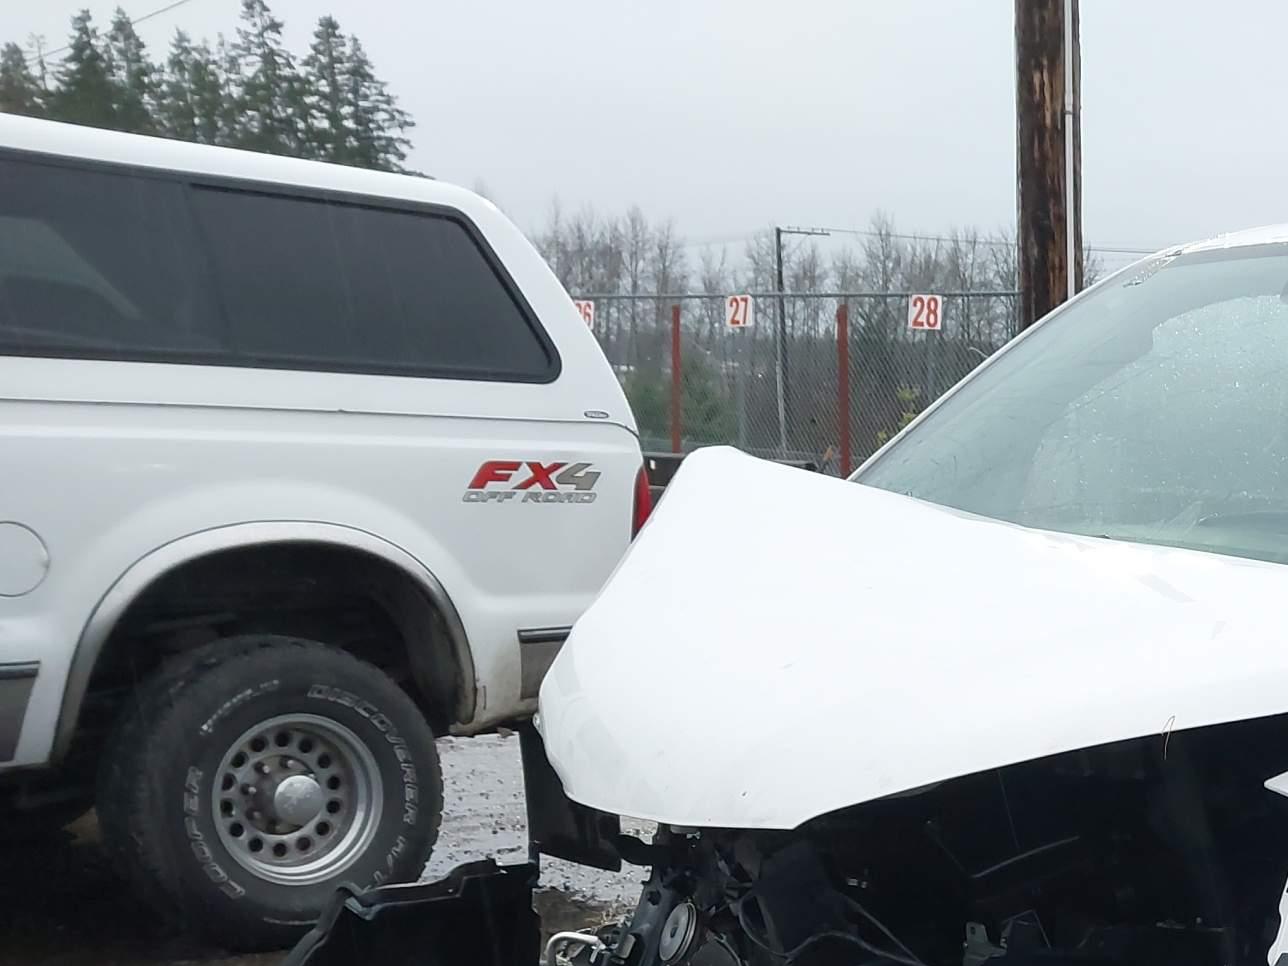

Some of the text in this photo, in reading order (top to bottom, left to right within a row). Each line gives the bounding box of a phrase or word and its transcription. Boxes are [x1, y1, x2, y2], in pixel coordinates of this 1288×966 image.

[728, 296, 749, 325] 27
[911, 296, 939, 328] 28
[467, 460, 602, 491] FX4
[462, 490, 598, 504] OFF ROAD
